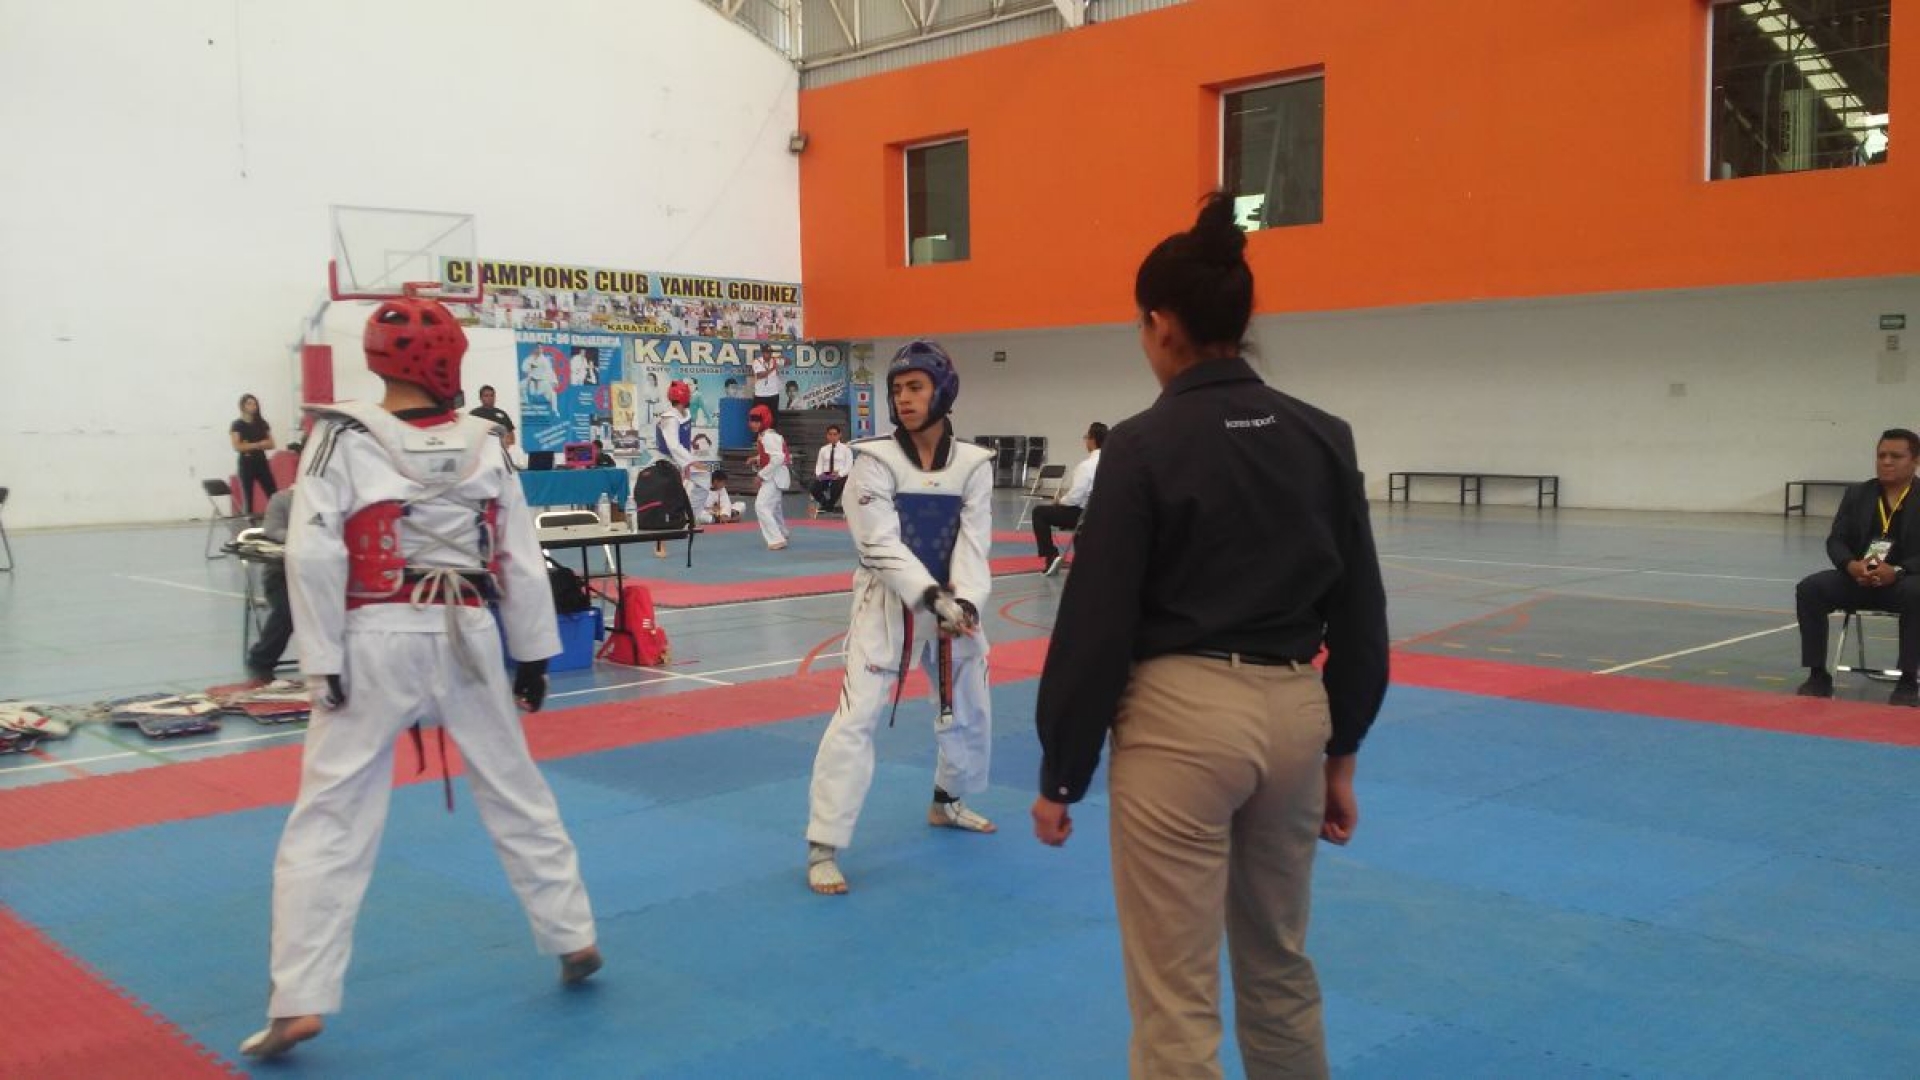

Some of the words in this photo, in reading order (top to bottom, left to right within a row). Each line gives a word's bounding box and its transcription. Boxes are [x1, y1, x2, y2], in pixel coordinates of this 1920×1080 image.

[594, 270, 649, 294] CLUB
[660, 276, 724, 298] YANKEL
[728, 281, 798, 303] GODINEZ
